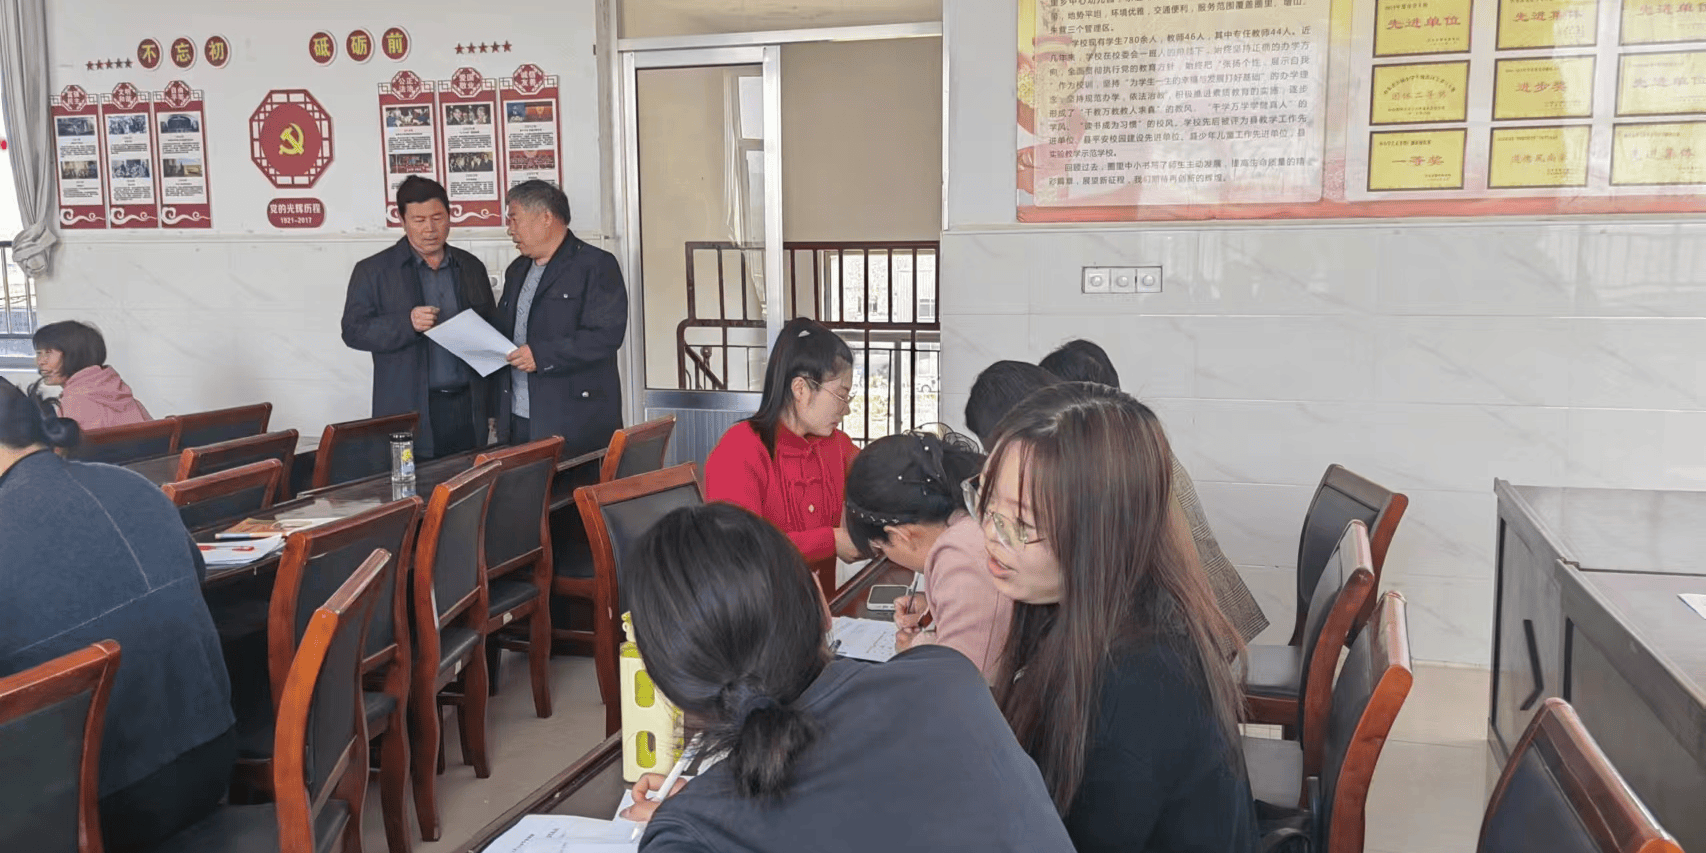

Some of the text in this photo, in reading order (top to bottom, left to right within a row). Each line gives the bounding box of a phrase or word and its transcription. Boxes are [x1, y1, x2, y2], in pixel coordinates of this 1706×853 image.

[1386, 15, 1461, 30] 先进单位
[141, 41, 224, 63] 不忘初
[313, 33, 403, 57] 砥砺前
[1392, 155, 1444, 166] 一等奖
[270, 203, 321, 213] 党的光辉历程
